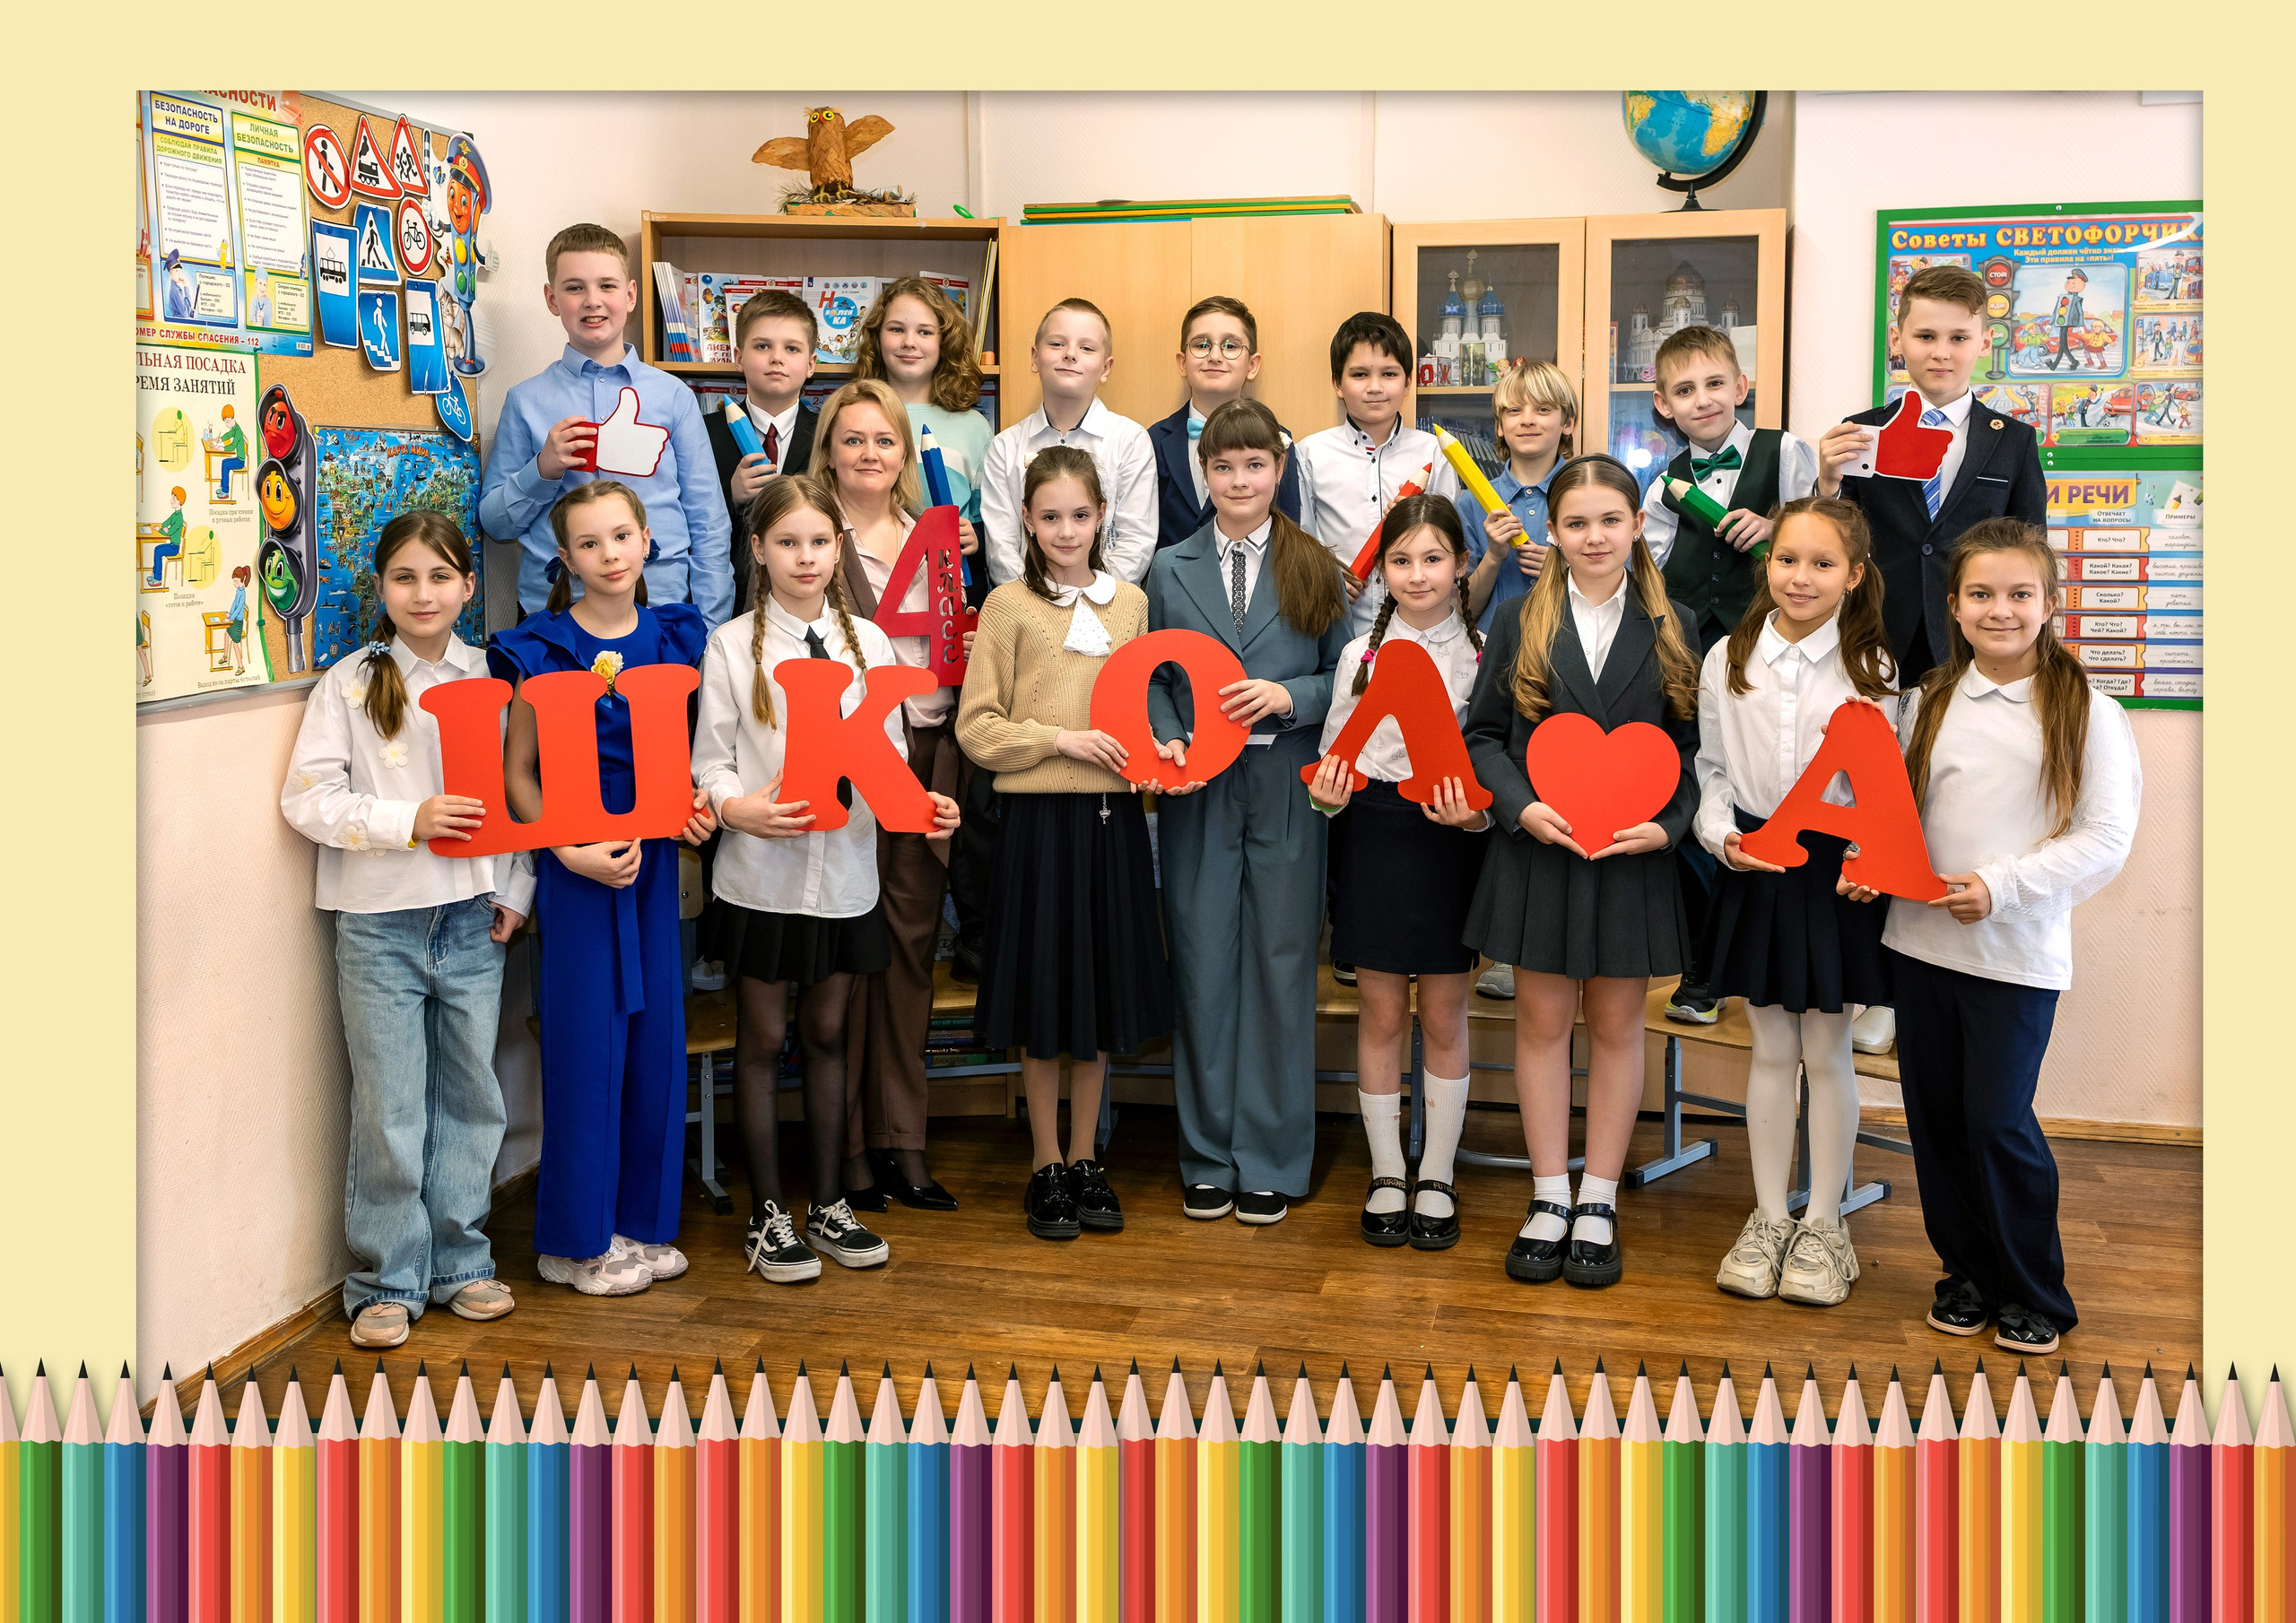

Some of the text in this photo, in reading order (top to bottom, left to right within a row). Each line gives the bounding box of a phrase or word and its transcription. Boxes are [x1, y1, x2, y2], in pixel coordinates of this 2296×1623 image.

[155, 100, 218, 123] БЕЗОПАСНОСТЬ
[165, 116, 210, 135] НА ДОРОГЕ
[249, 123, 279, 138] ЛИЧНАЯ
[160, 136, 218, 155] СОБЛЮДАЙ ПРАВИЛА
[236, 133, 293, 153] БЕЗОПАСНОСТЬ
[156, 144, 222, 165] ДОРОЖНОГО ДВИЖЕНИЯ
[257, 157, 280, 168] ПАМЯТКА
[1892, 230, 1987, 250] Советы
[2013, 248, 2046, 256] Каждый
[2048, 248, 2078, 256] должен
[2079, 247, 2101, 255] чётко
[159, 329, 196, 341] СЛУЖБЫ
[197, 332, 239, 344] СПАСЕНИЯ
[247, 337, 259, 347] 112
[186, 355, 247, 376] ПОСАДКА
[1439, 362, 1451, 384] Ж
[173, 378, 236, 395] ЗАНЯТИЙ
[387, 444, 430, 459] КАРТА МИРА
[2067, 485, 2129, 504] РЕЧИ
[872, 505, 978, 687] 4
